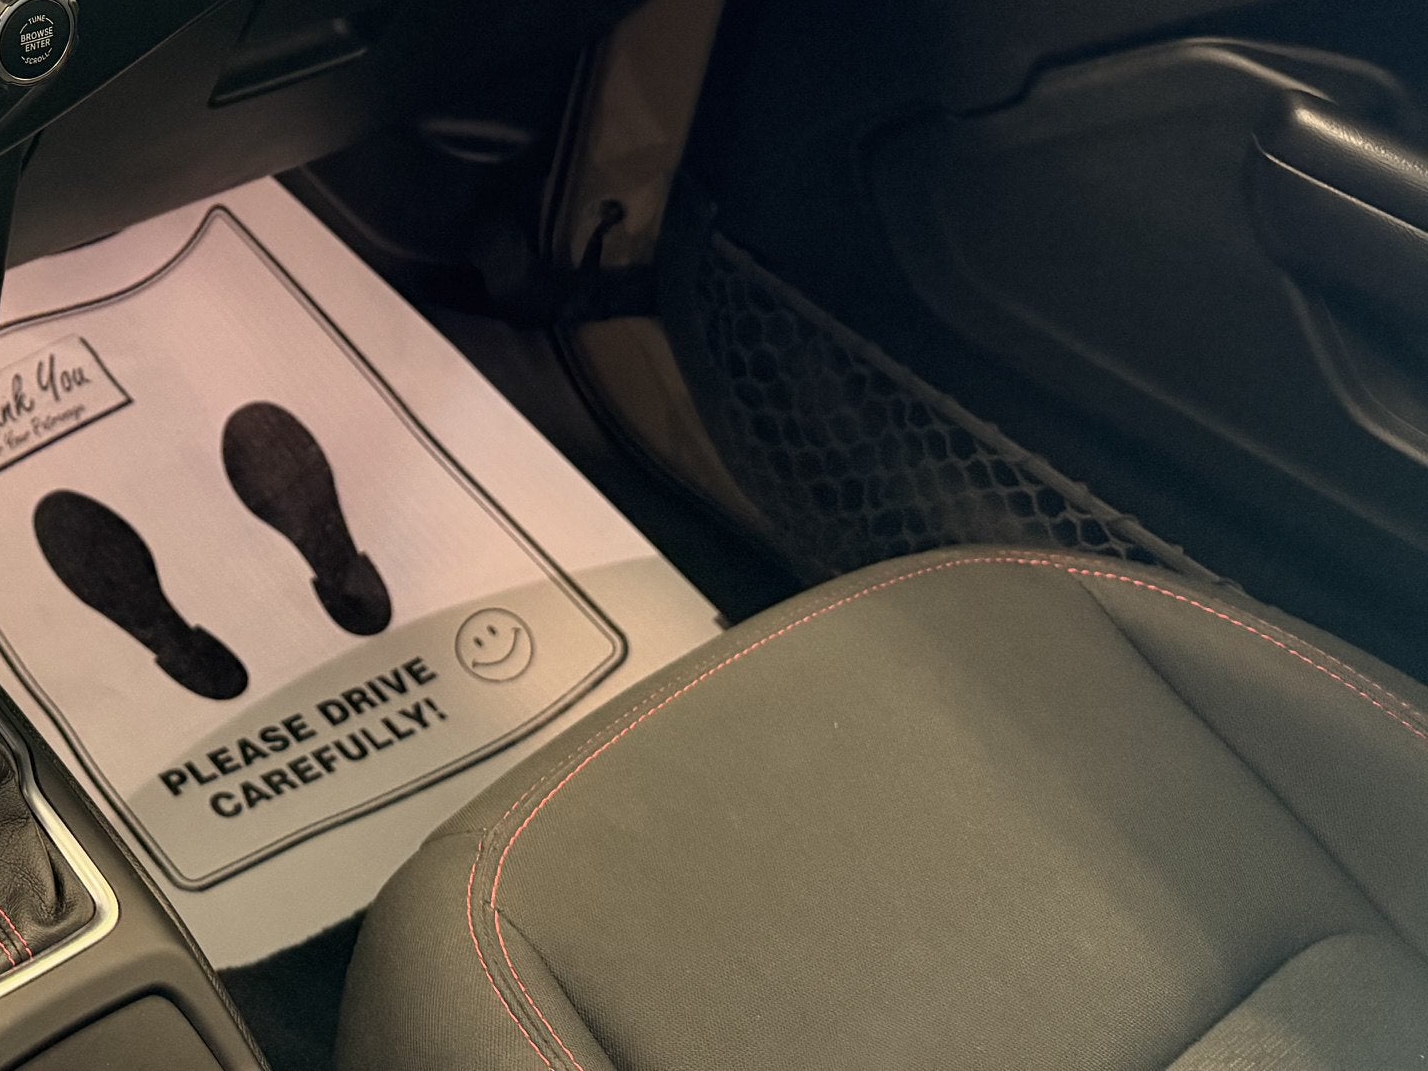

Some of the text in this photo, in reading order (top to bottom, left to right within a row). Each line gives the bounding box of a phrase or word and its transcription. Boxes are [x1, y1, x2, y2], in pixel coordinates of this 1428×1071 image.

[28, 14, 46, 25] TUNE
[20, 26, 53, 43] BROWSE
[25, 38, 51, 53] ENTER
[24, 51, 50, 65] SCROLL
[36, 353, 91, 402] You
[158, 656, 438, 797] PLEASE DRIVE
[208, 697, 448, 818] CAREFULLY!
